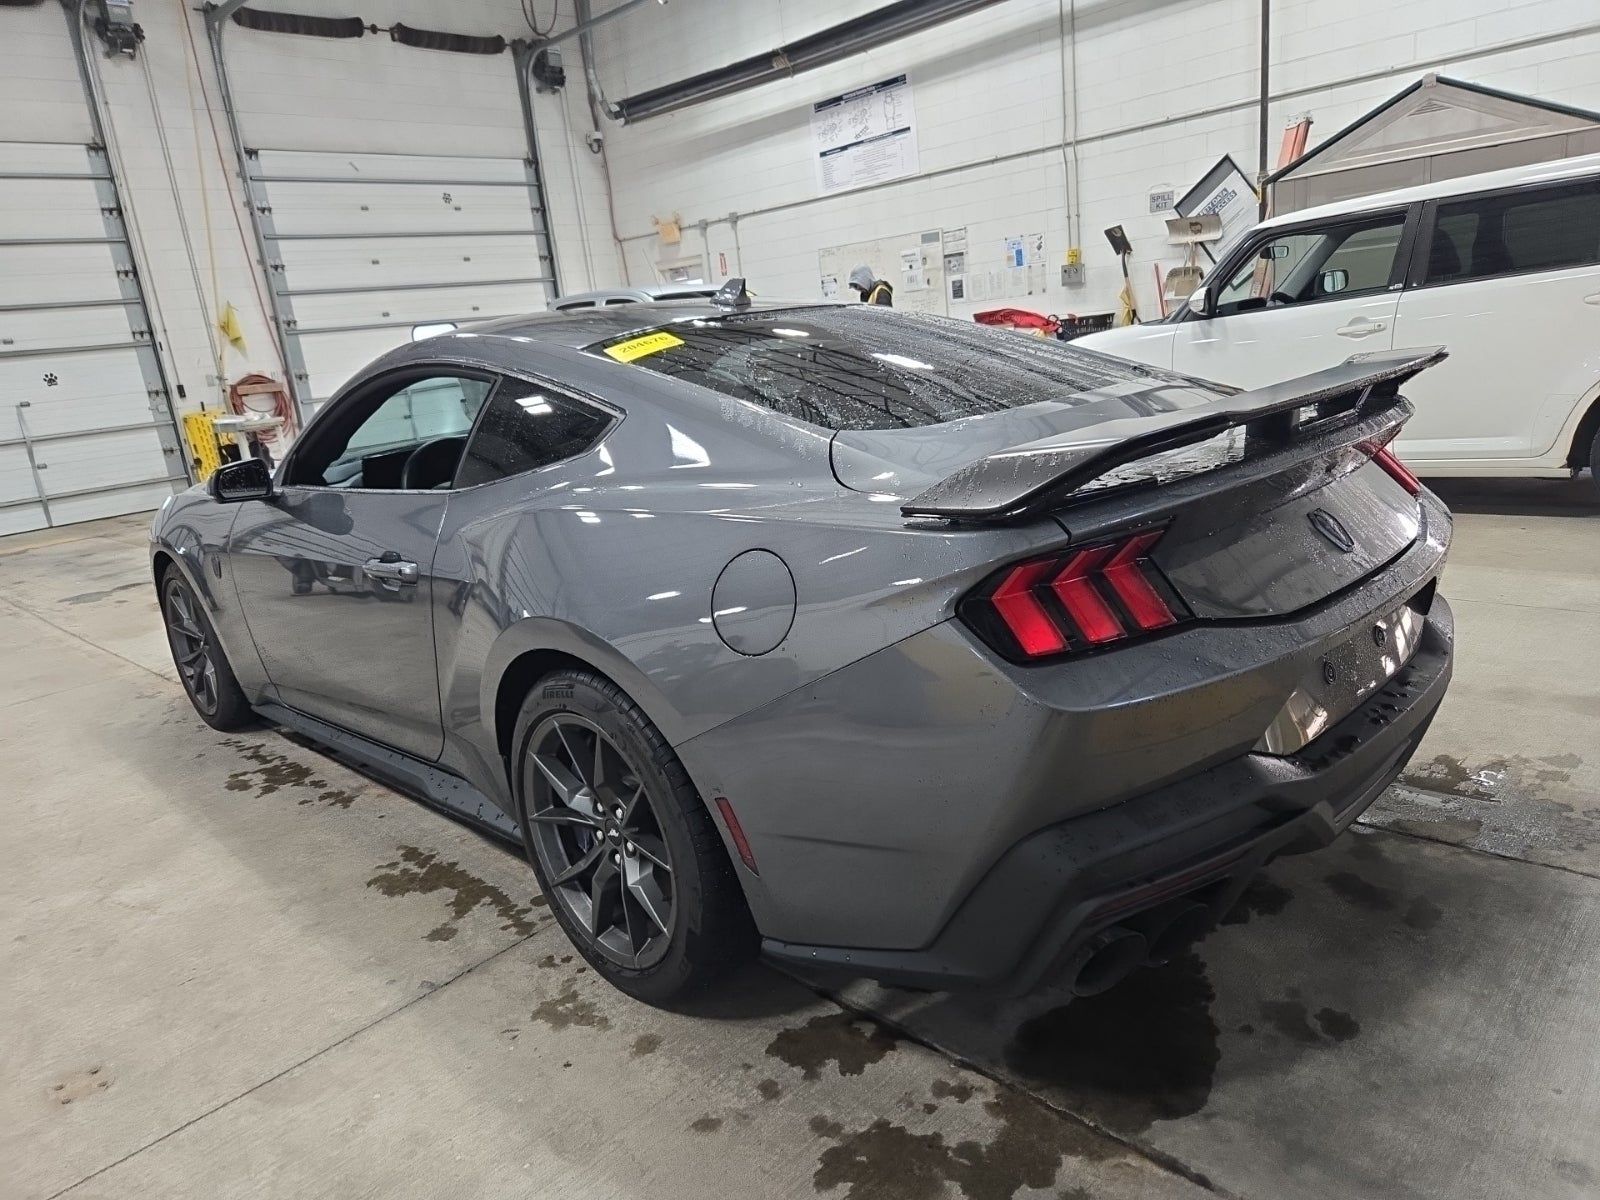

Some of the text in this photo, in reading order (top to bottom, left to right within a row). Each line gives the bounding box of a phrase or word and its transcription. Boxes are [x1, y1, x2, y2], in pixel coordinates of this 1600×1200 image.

[1151, 194, 1172, 203] SPILL
[1211, 189, 1228, 205] DATA
[1214, 191, 1236, 212] ACCESS
[1155, 201, 1168, 209] KIT
[542, 684, 575, 699] PIRELLI
